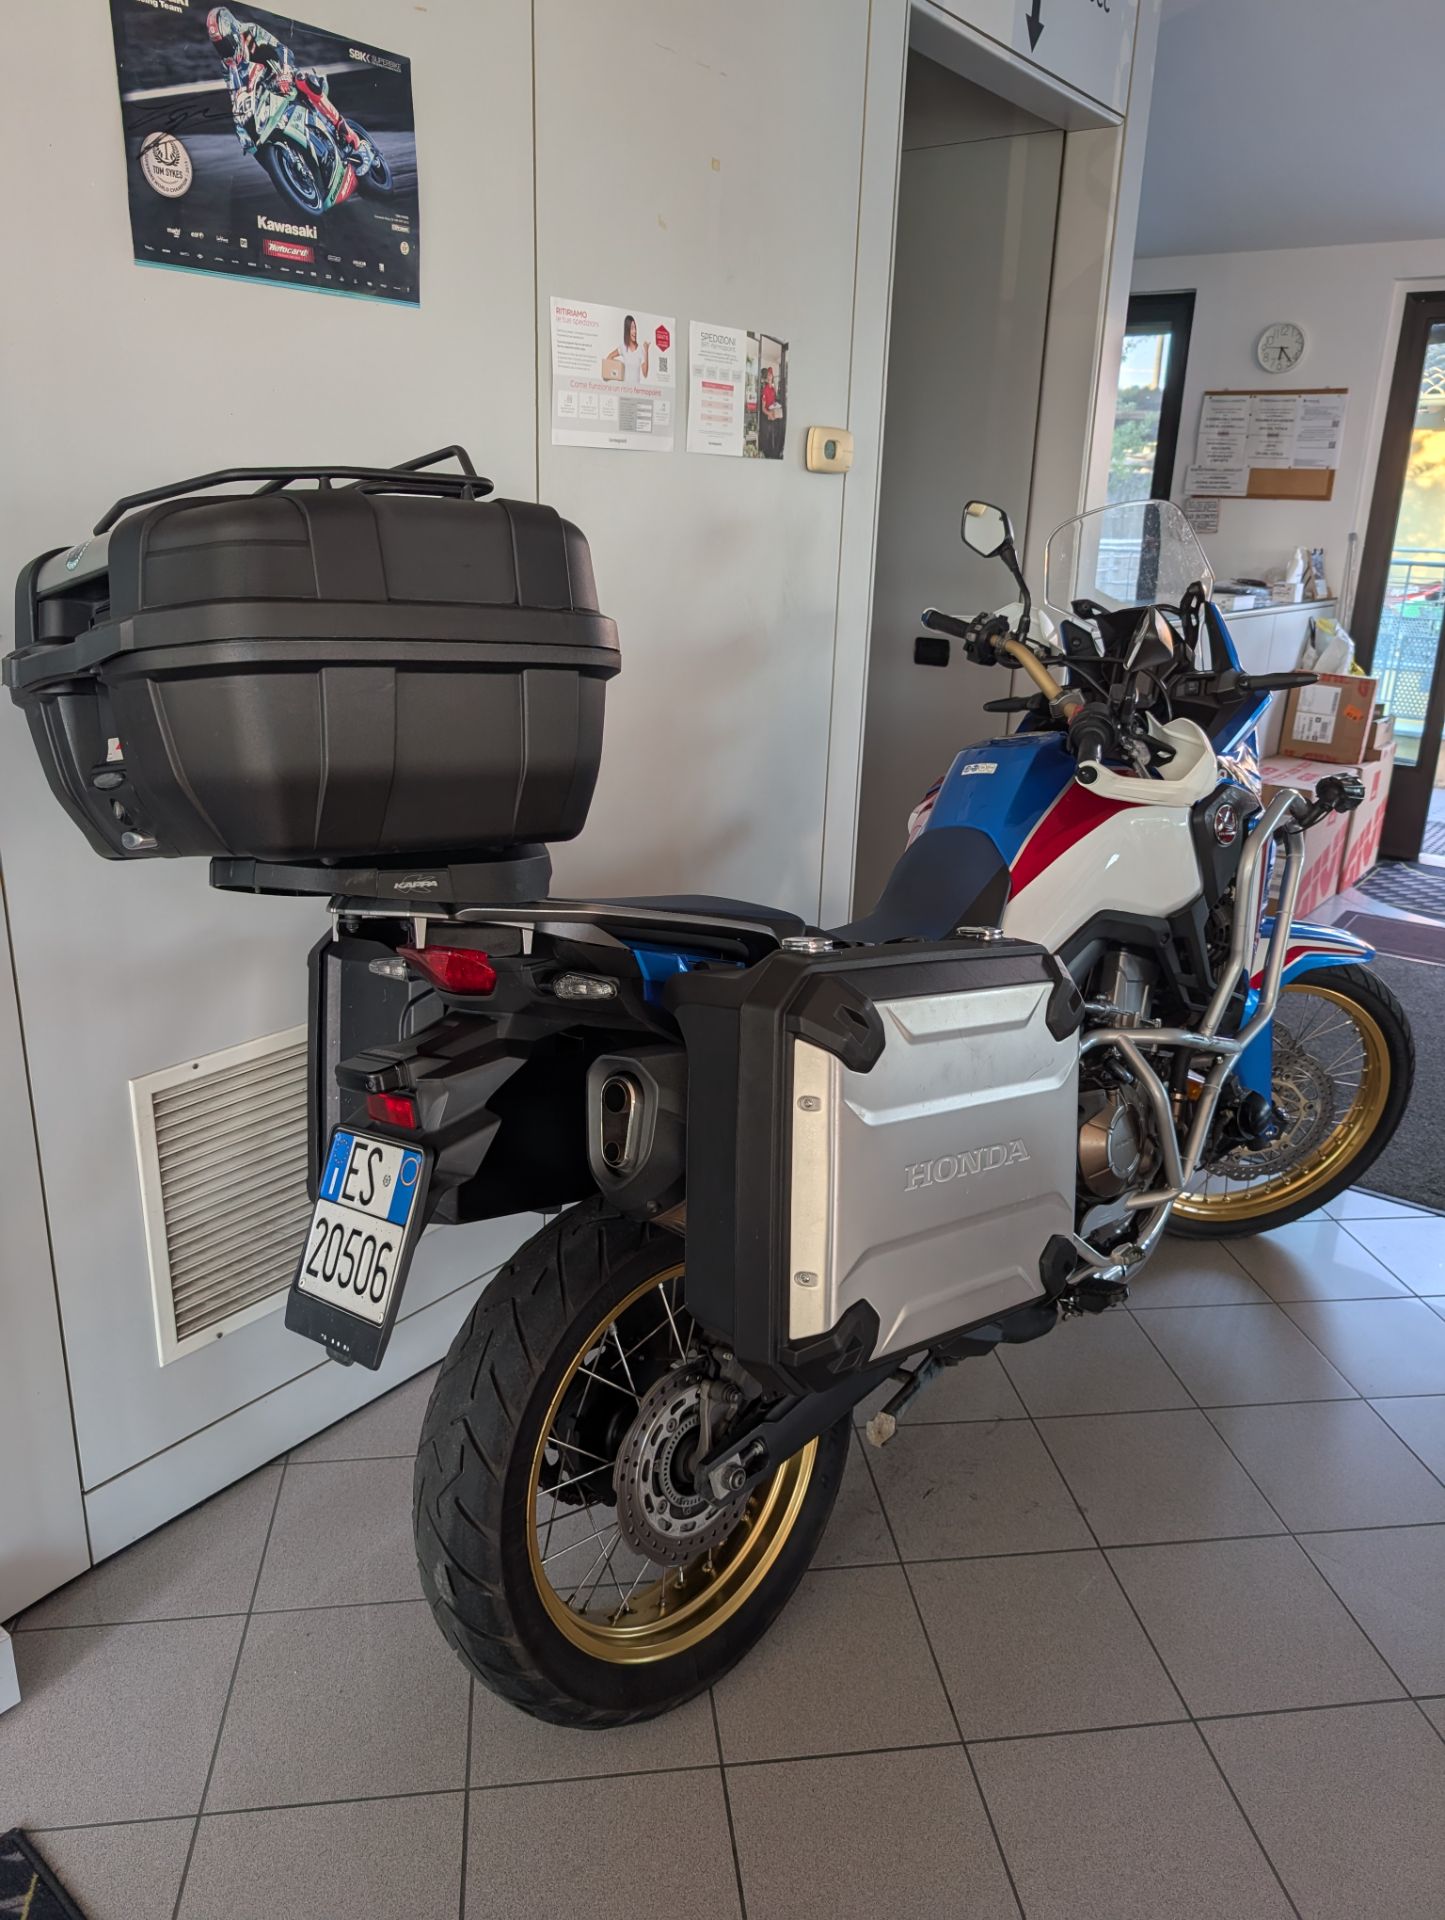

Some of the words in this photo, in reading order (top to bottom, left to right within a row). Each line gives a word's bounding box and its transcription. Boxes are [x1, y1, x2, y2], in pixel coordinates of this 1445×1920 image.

[160, 0, 183, 13] Team
[152, 165, 165, 176] TOM
[165, 167, 183, 179] SYKES
[257, 215, 318, 239] Kawasaki
[556, 306, 588, 319] RITIRIAMO
[701, 332, 737, 346] SPEDIZIONI
[569, 379, 588, 390] Come
[393, 880, 438, 889] KAPPA
[904, 1137, 1031, 1192] HONDA
[341, 1141, 383, 1206] ES
[305, 1217, 393, 1304] 20506
